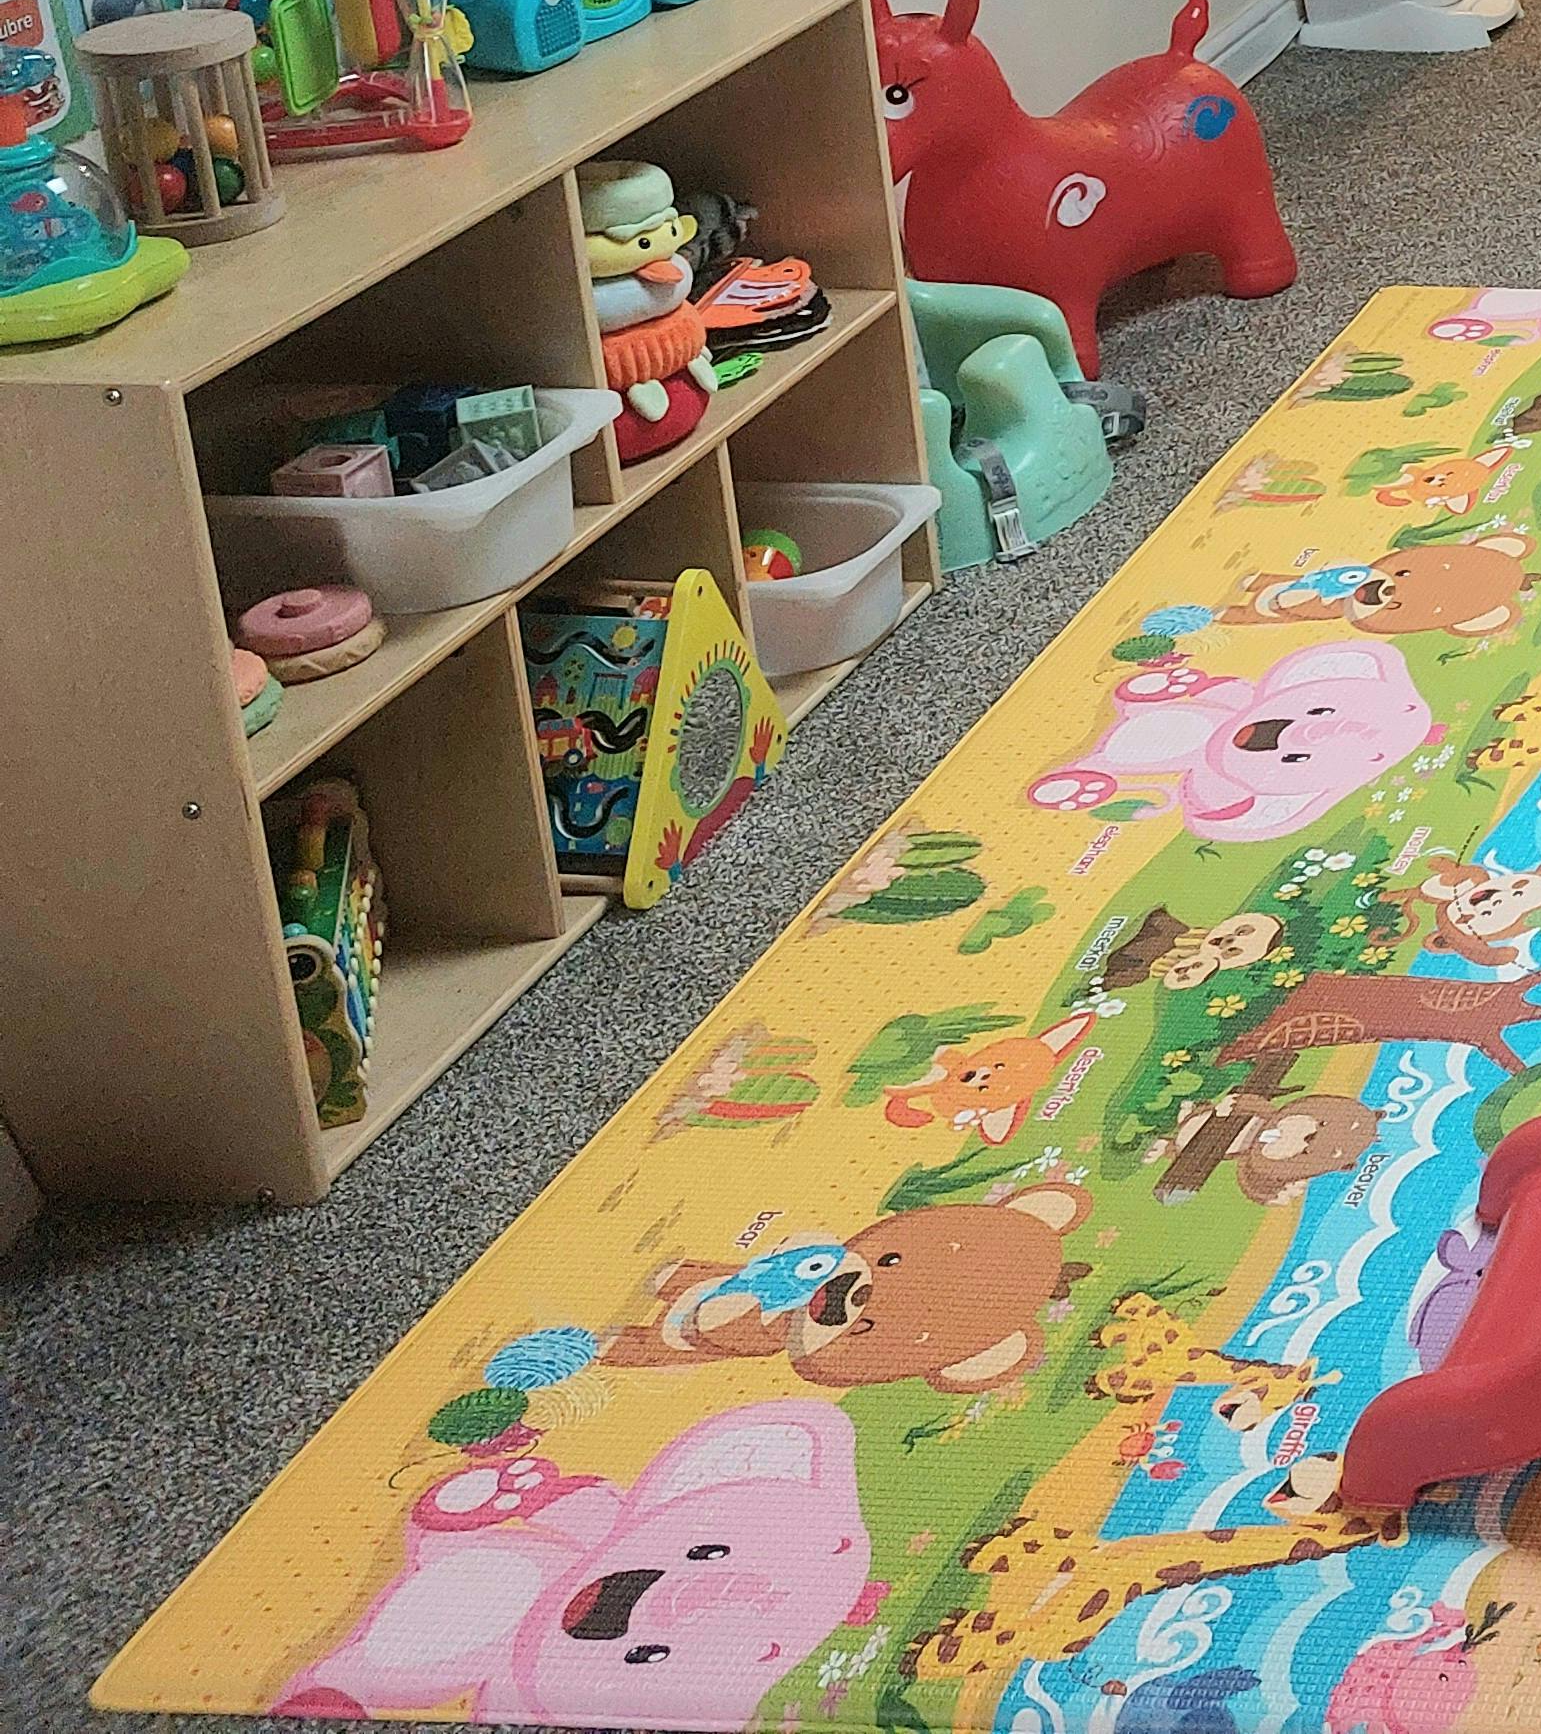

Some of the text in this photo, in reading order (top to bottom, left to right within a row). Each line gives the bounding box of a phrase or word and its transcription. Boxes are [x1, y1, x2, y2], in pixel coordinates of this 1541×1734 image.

[1057, 1048, 1101, 1092] desert
[1343, 1154, 1391, 1208] beaver
[736, 1210, 782, 1249] bear
[1274, 1403, 1317, 1466] giraffe
